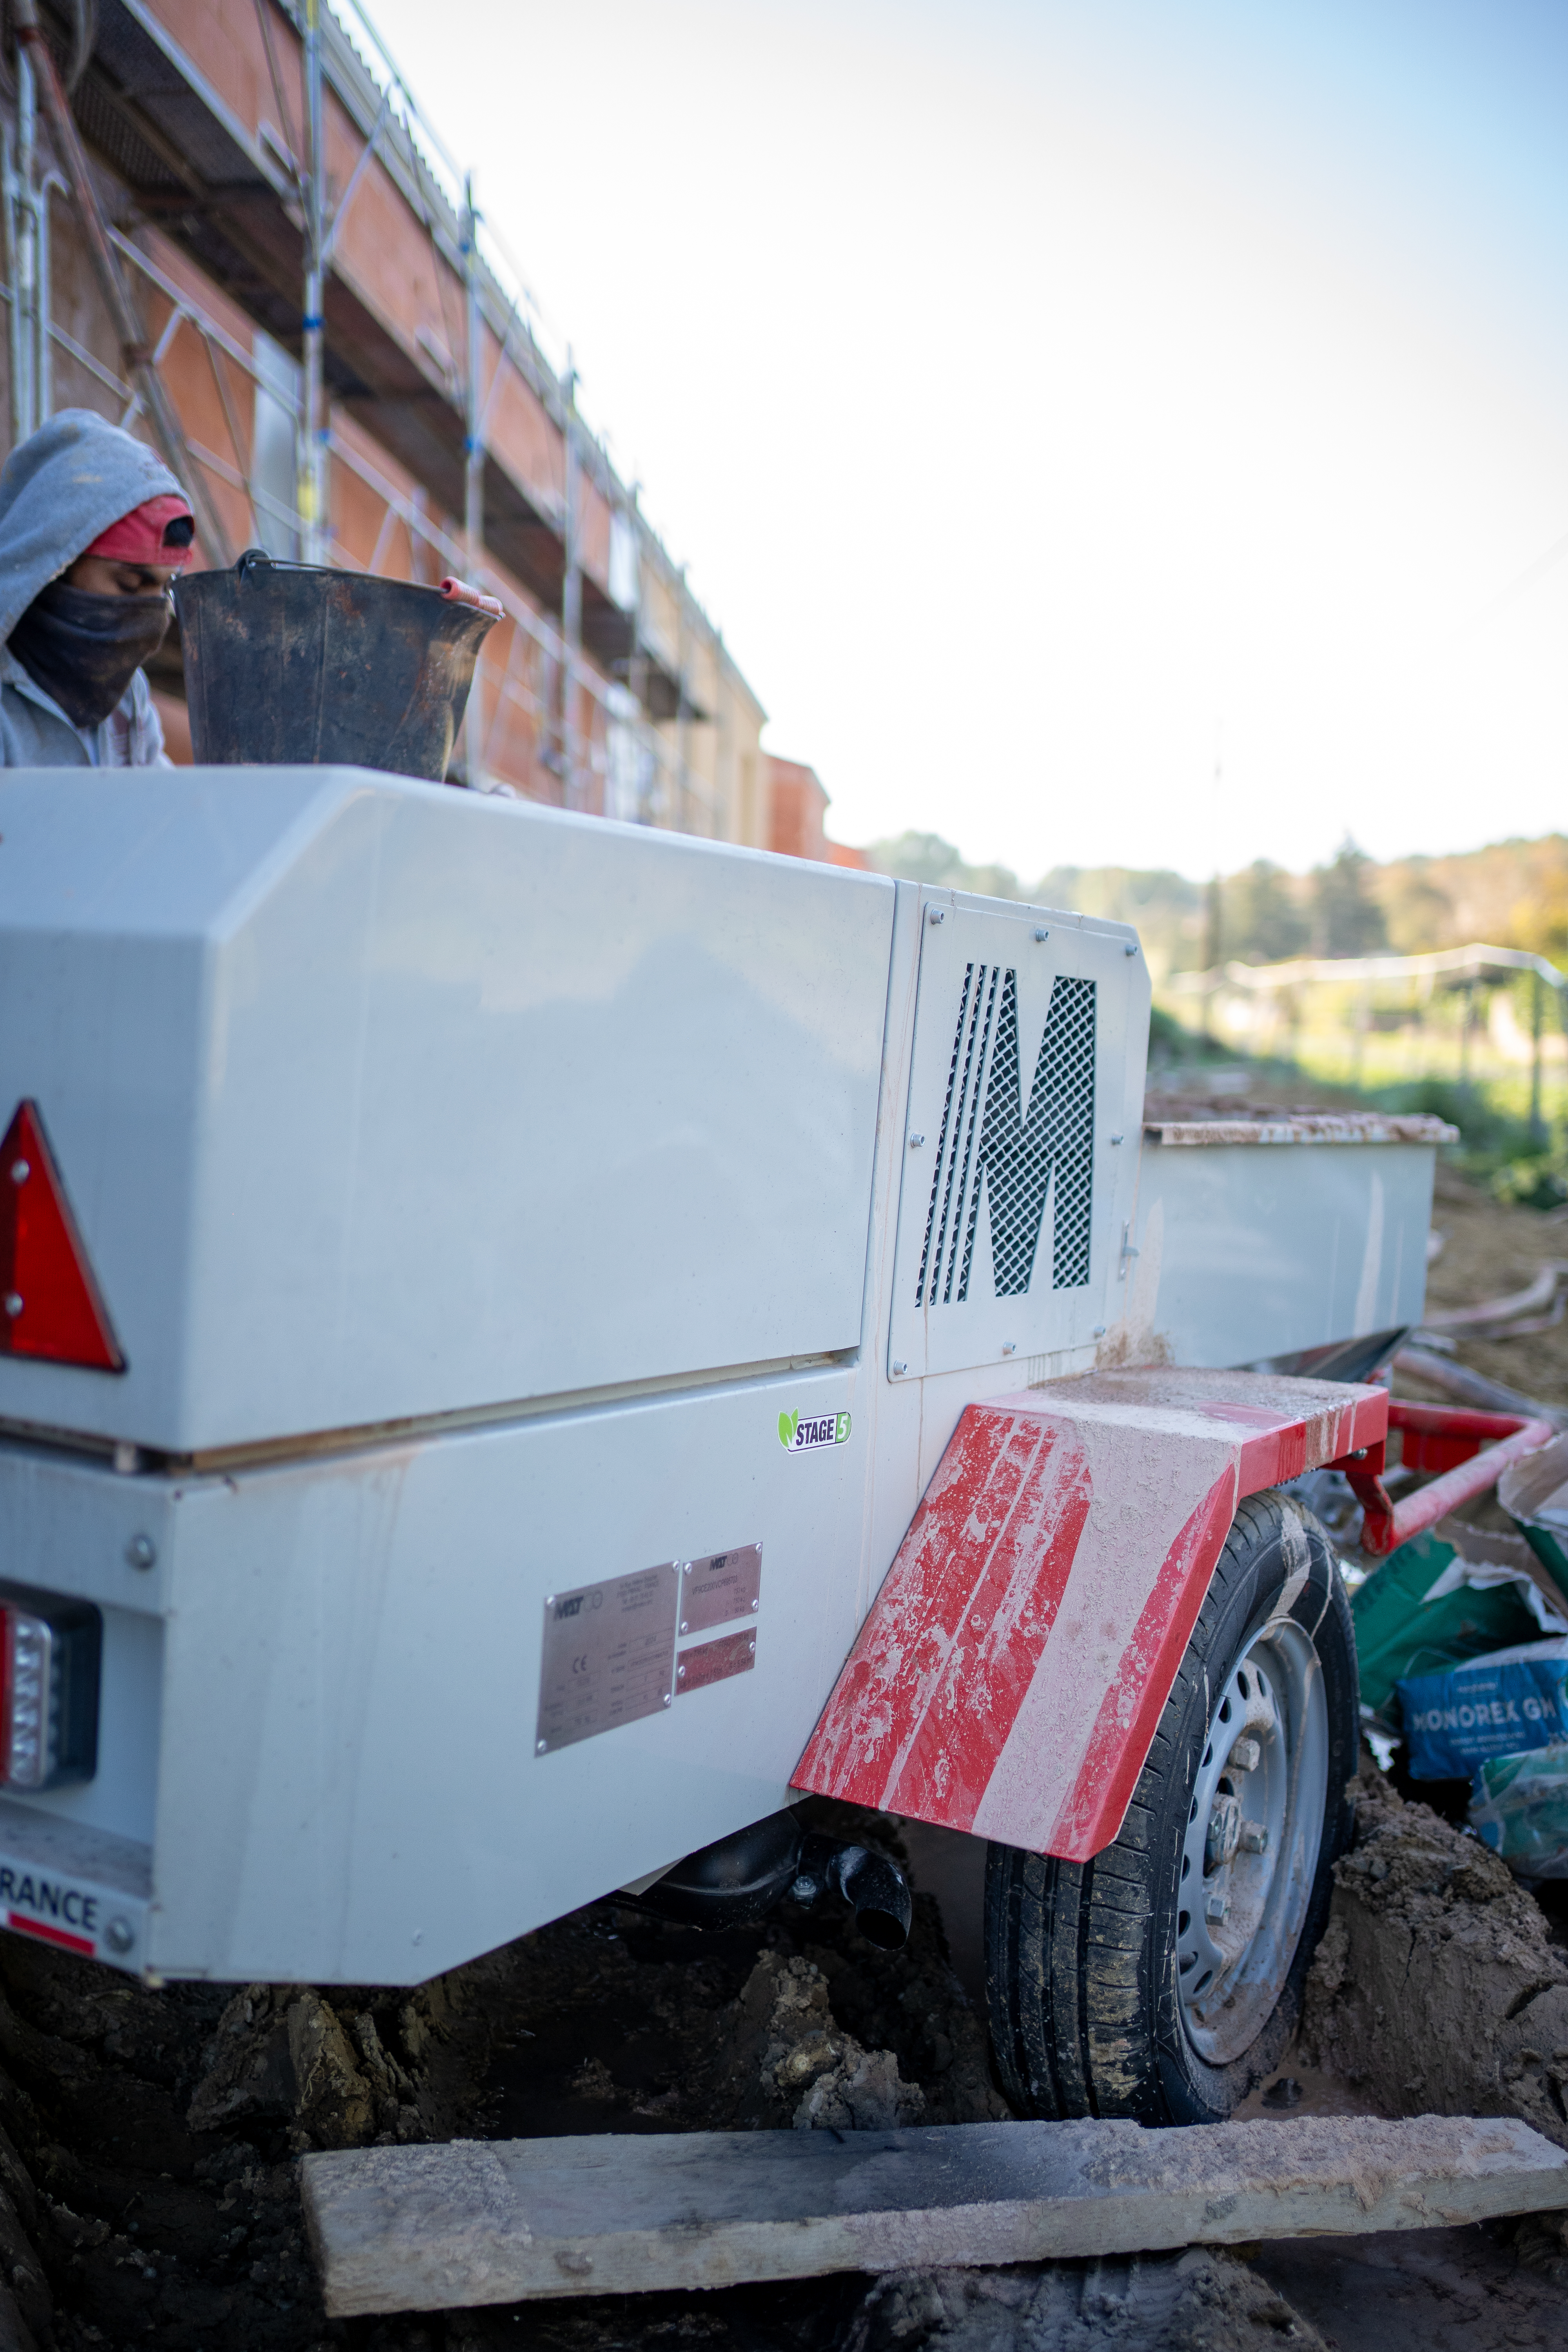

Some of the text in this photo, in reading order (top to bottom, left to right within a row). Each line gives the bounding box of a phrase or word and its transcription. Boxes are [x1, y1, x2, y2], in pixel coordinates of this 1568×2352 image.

[796, 1415, 848, 1446] STAGE 5
[573, 1655, 587, 1674] CE
[1412, 1700, 1521, 1732] MONOREX
